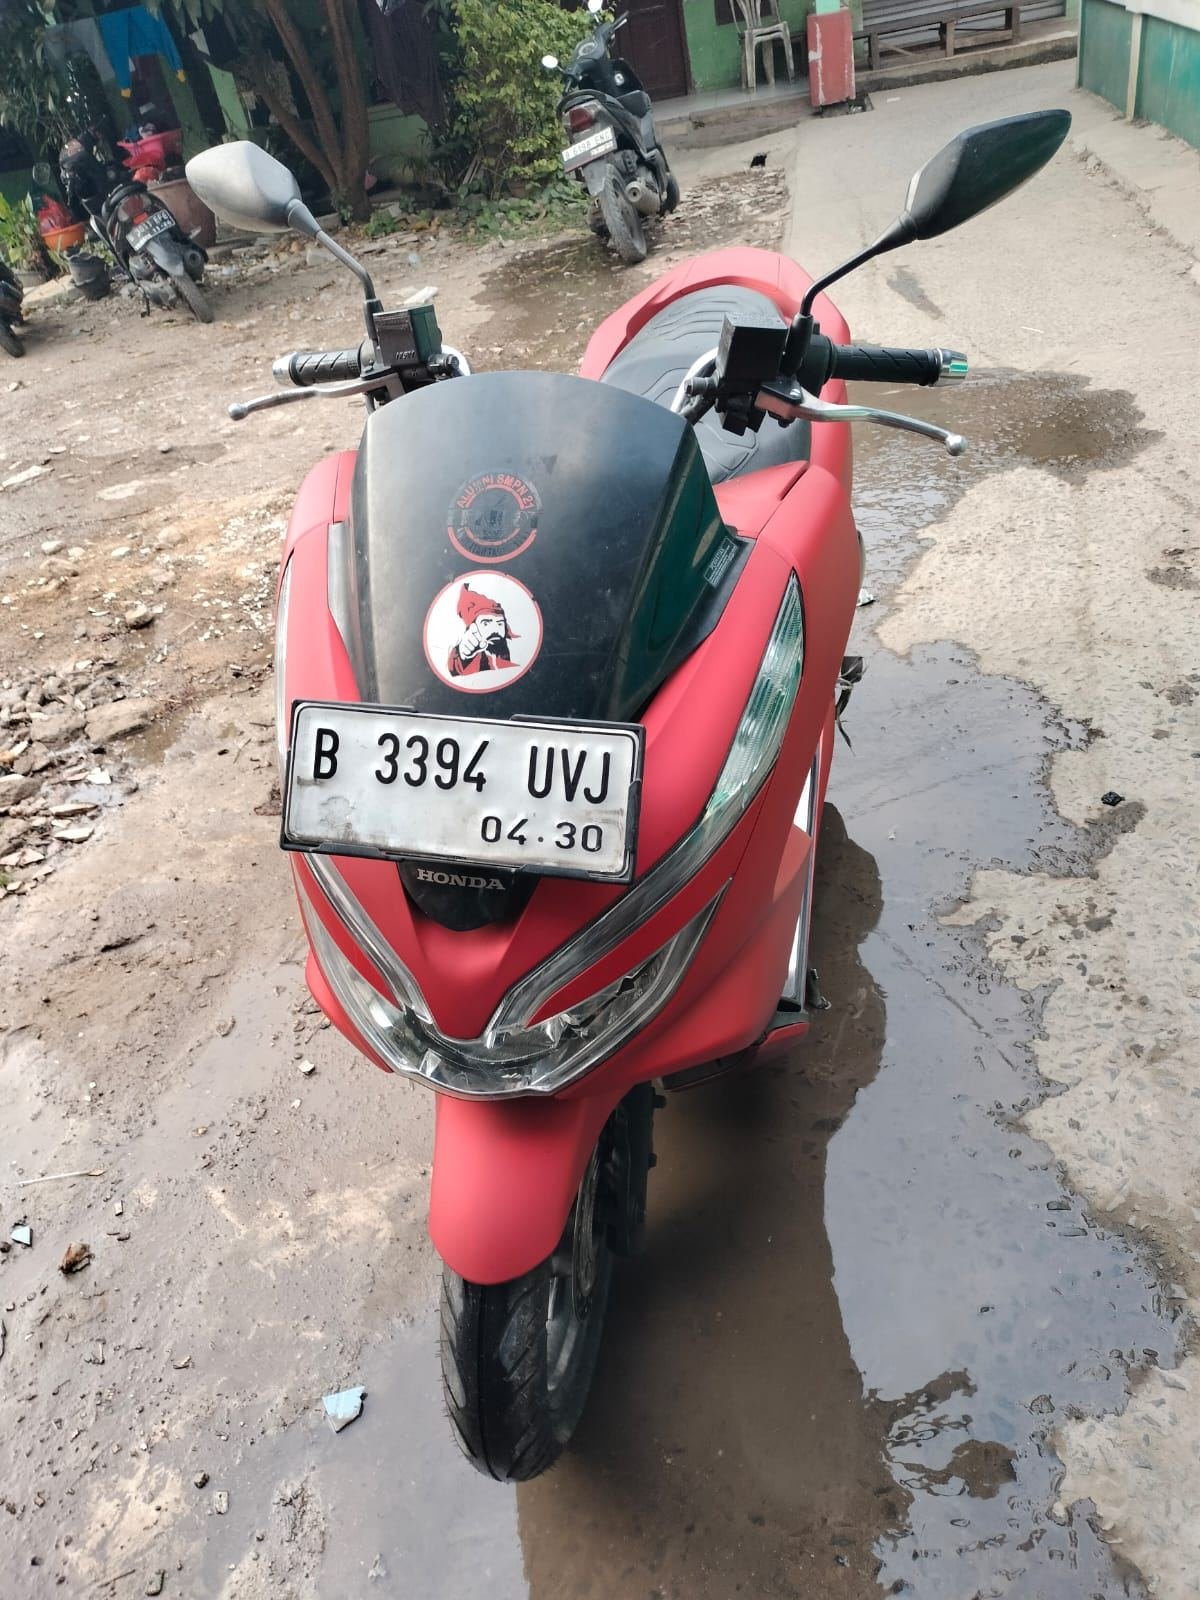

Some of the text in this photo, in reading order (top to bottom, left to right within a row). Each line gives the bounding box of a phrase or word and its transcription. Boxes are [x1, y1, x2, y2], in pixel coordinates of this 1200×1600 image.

[496, 473, 529, 497] SMPN
[522, 494, 537, 510] 21
[313, 728, 611, 804] B 3394 UVJ
[416, 868, 506, 890] HONDA
